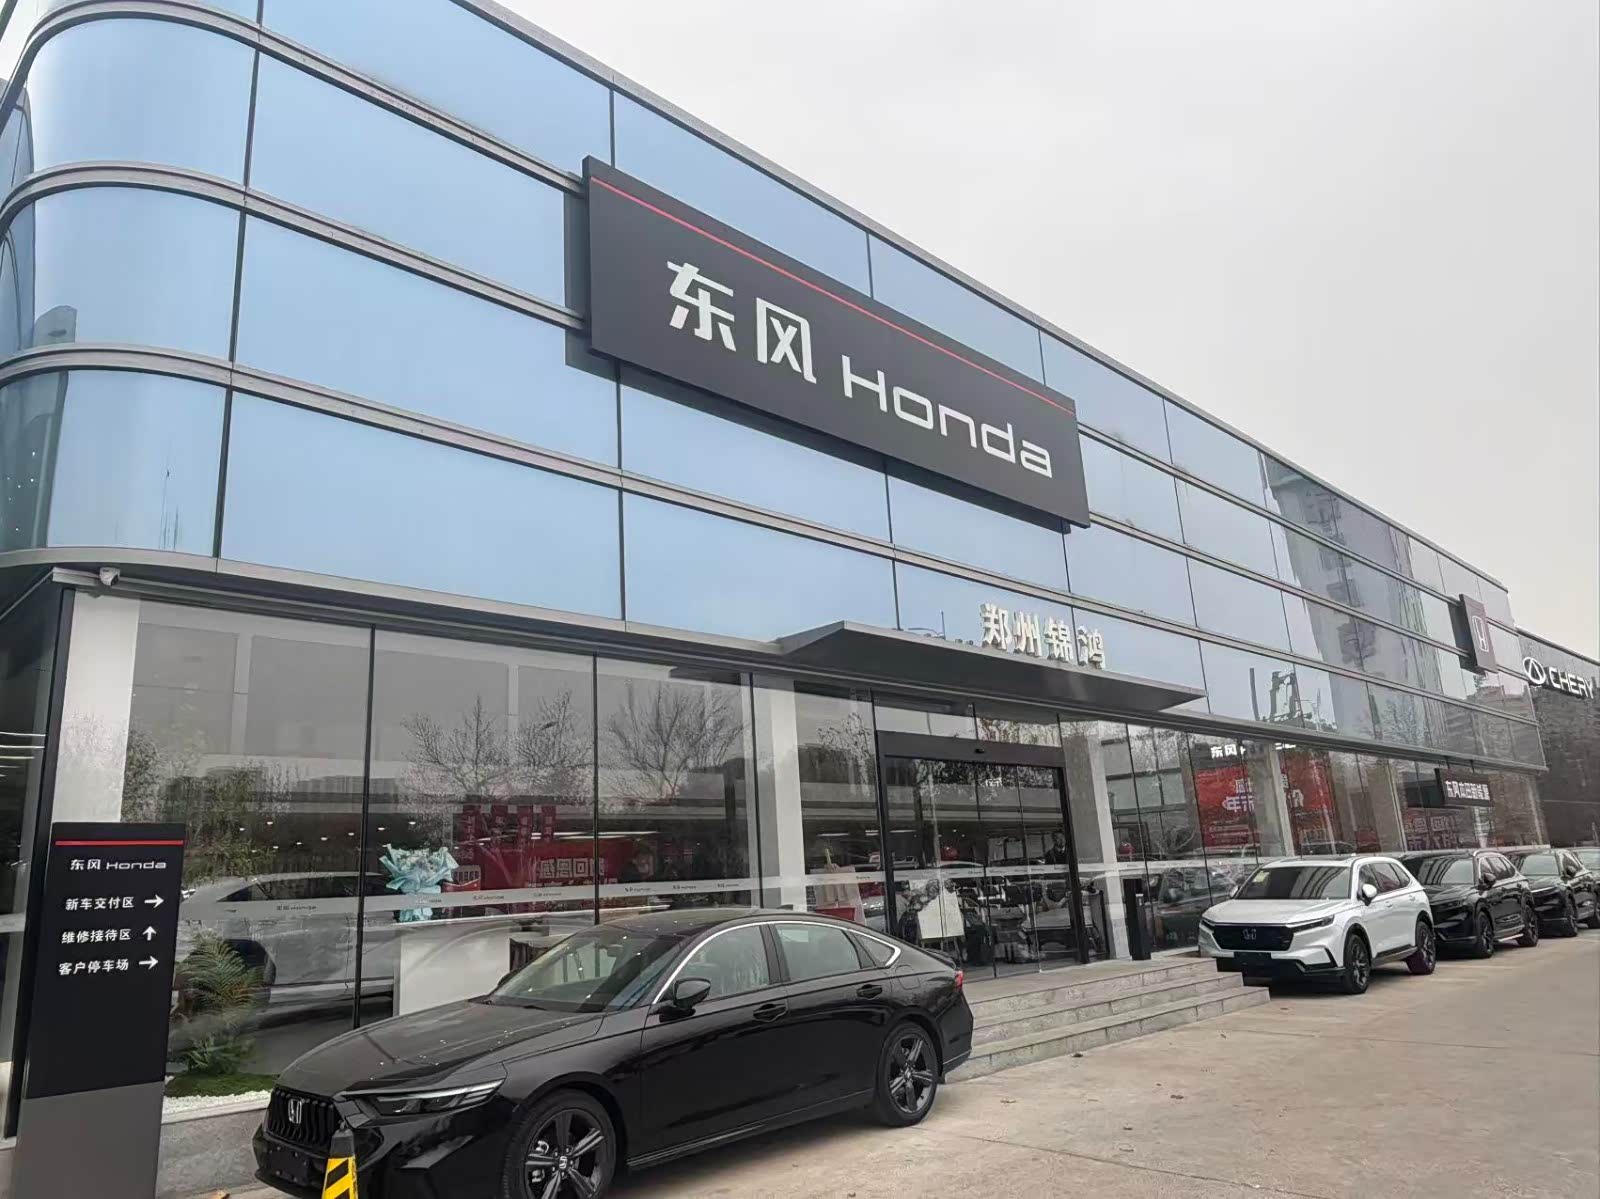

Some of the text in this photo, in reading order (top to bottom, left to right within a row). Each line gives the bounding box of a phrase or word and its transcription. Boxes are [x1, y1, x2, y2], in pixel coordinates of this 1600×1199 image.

[667, 261, 1053, 479] 东风 Honda
[980, 602, 1106, 670] 郑州锦鸿
[1548, 667, 1594, 699] CHERY
[70, 858, 167, 871] 东风 Honda
[65, 895, 135, 911] 新车交付区
[61, 927, 131, 945] 维修接待区
[58, 957, 129, 976] 客户停车场
